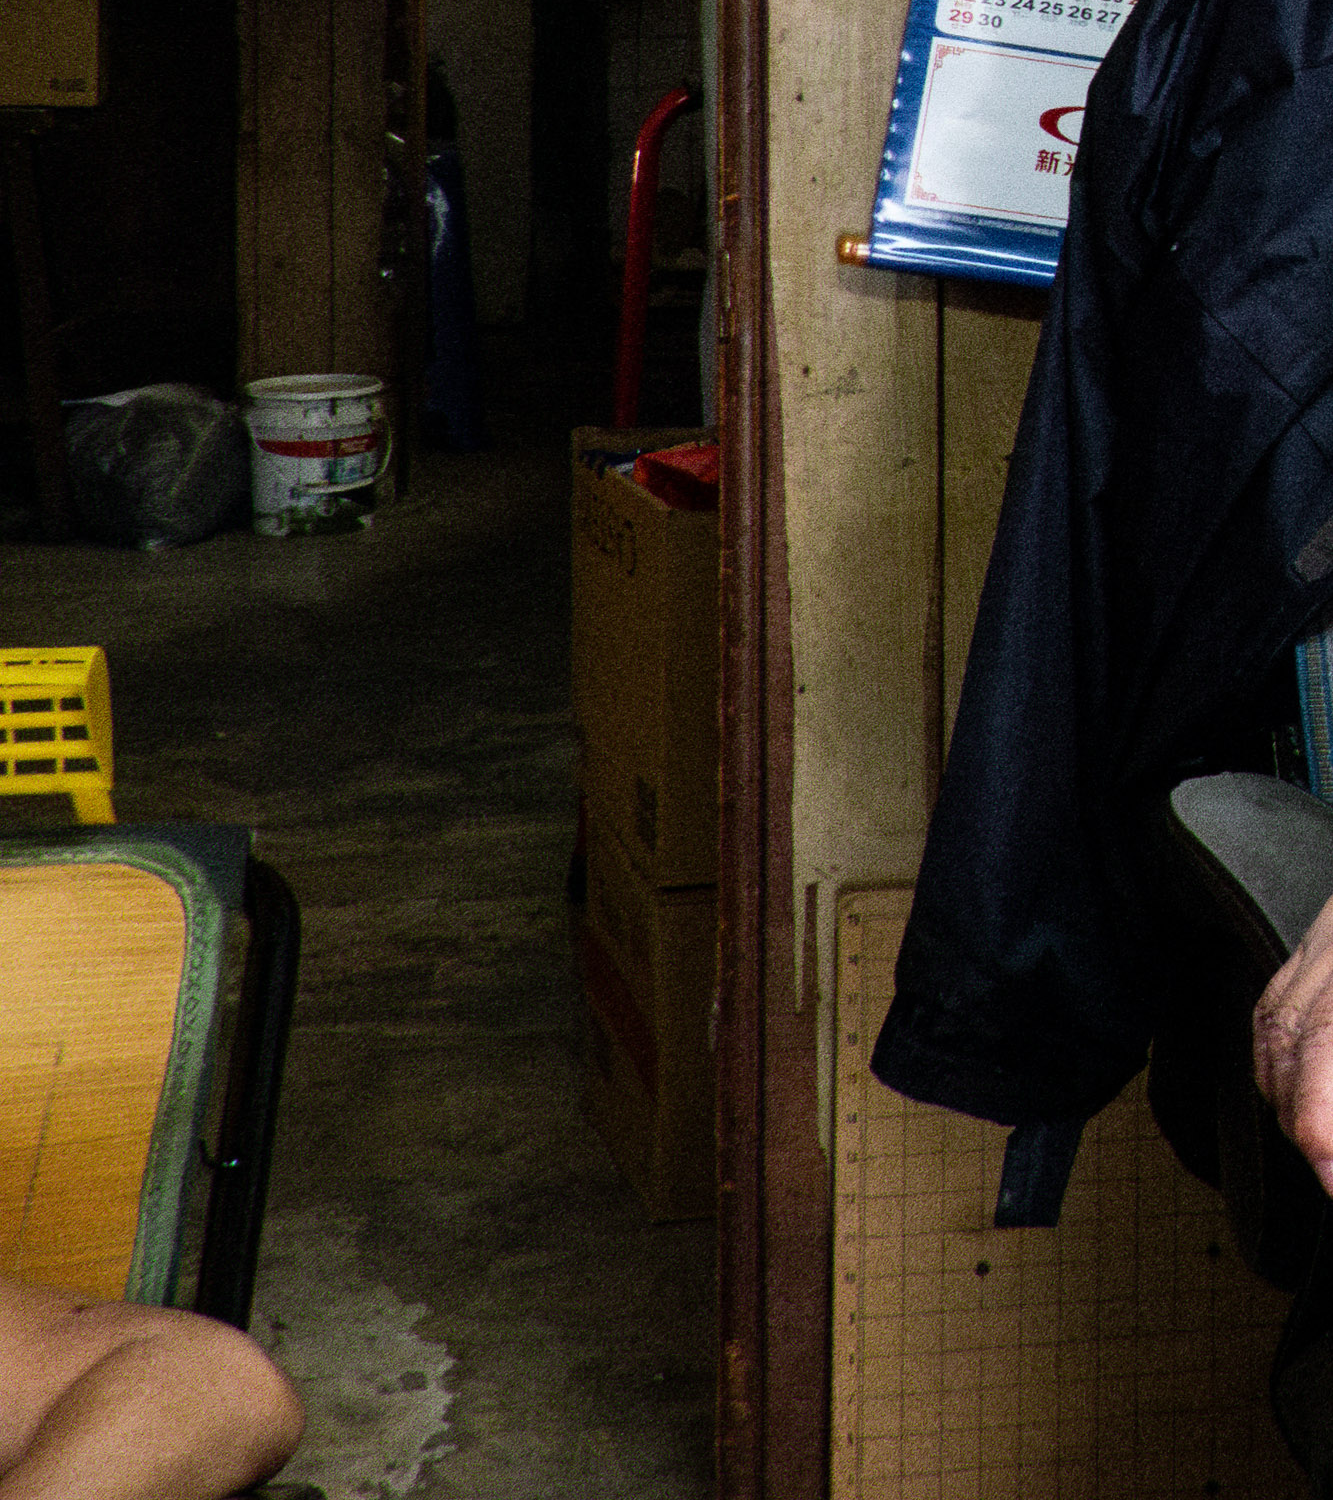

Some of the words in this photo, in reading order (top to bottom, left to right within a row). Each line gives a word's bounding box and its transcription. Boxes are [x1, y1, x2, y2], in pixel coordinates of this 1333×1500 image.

[949, 10, 973, 23] 29
[979, 13, 1003, 28] 30
[1039, 1, 1063, 16] 25
[1068, 6, 1092, 20] 26
[1097, 11, 1121, 24] 27
